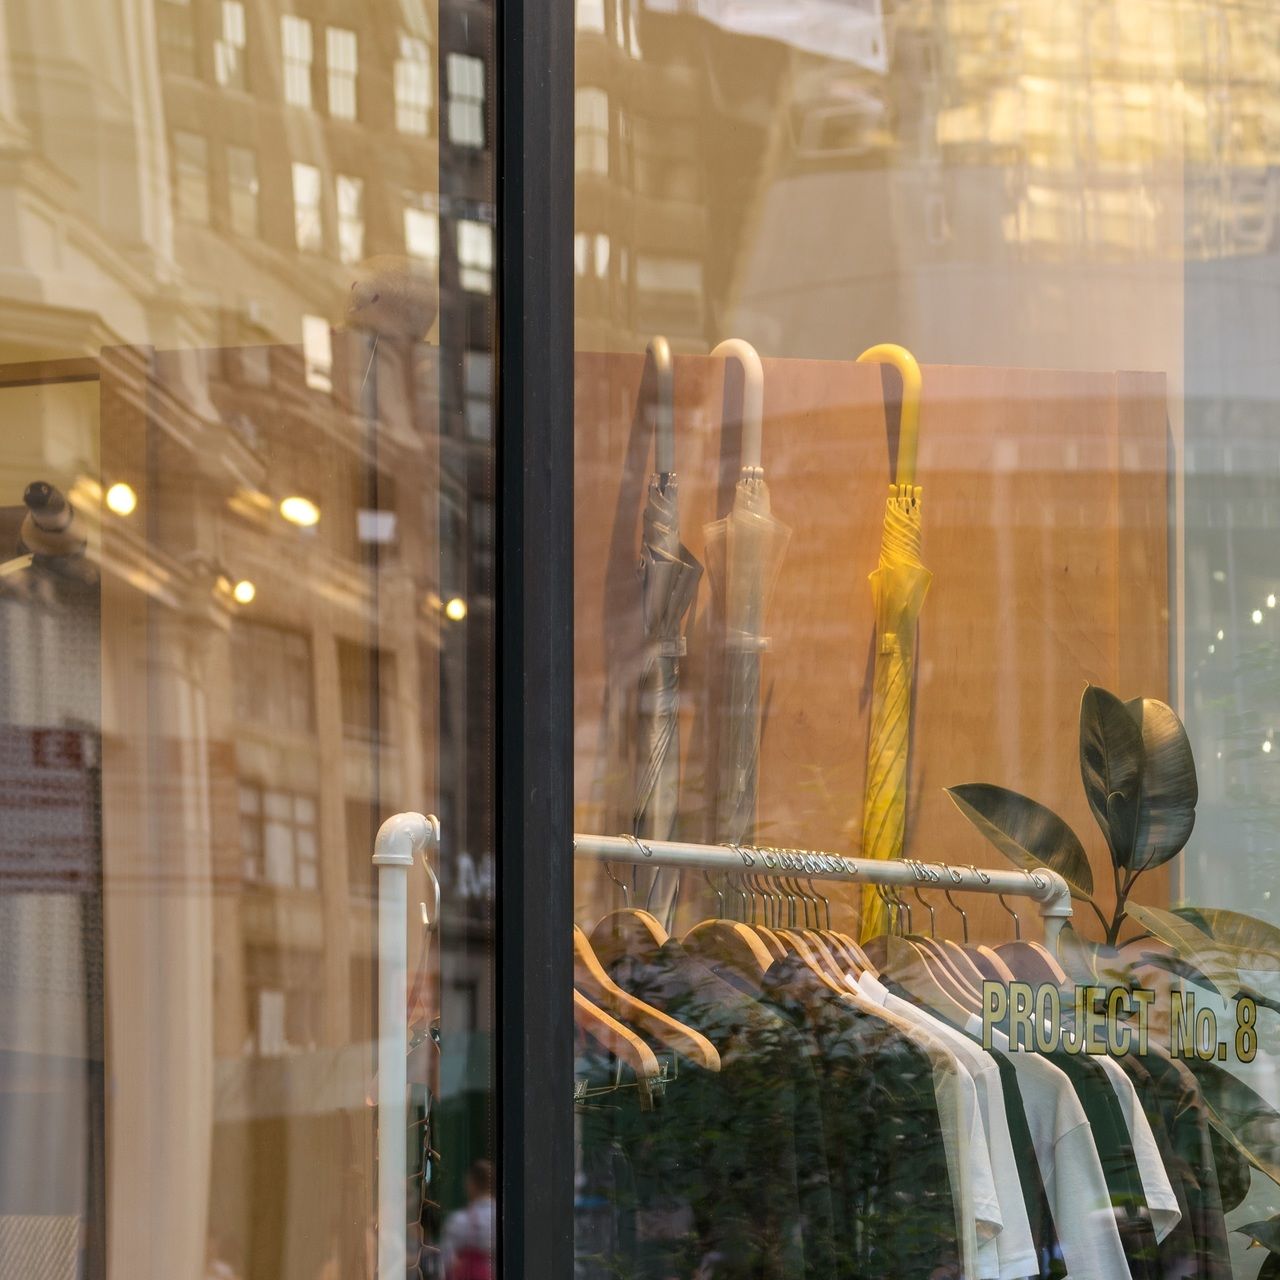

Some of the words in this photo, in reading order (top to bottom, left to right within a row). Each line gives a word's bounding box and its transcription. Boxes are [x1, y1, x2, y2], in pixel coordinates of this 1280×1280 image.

[982, 979, 1155, 1057] PROJECT
[1170, 990, 1227, 1061] No.
[1235, 997, 1258, 1063] 8
